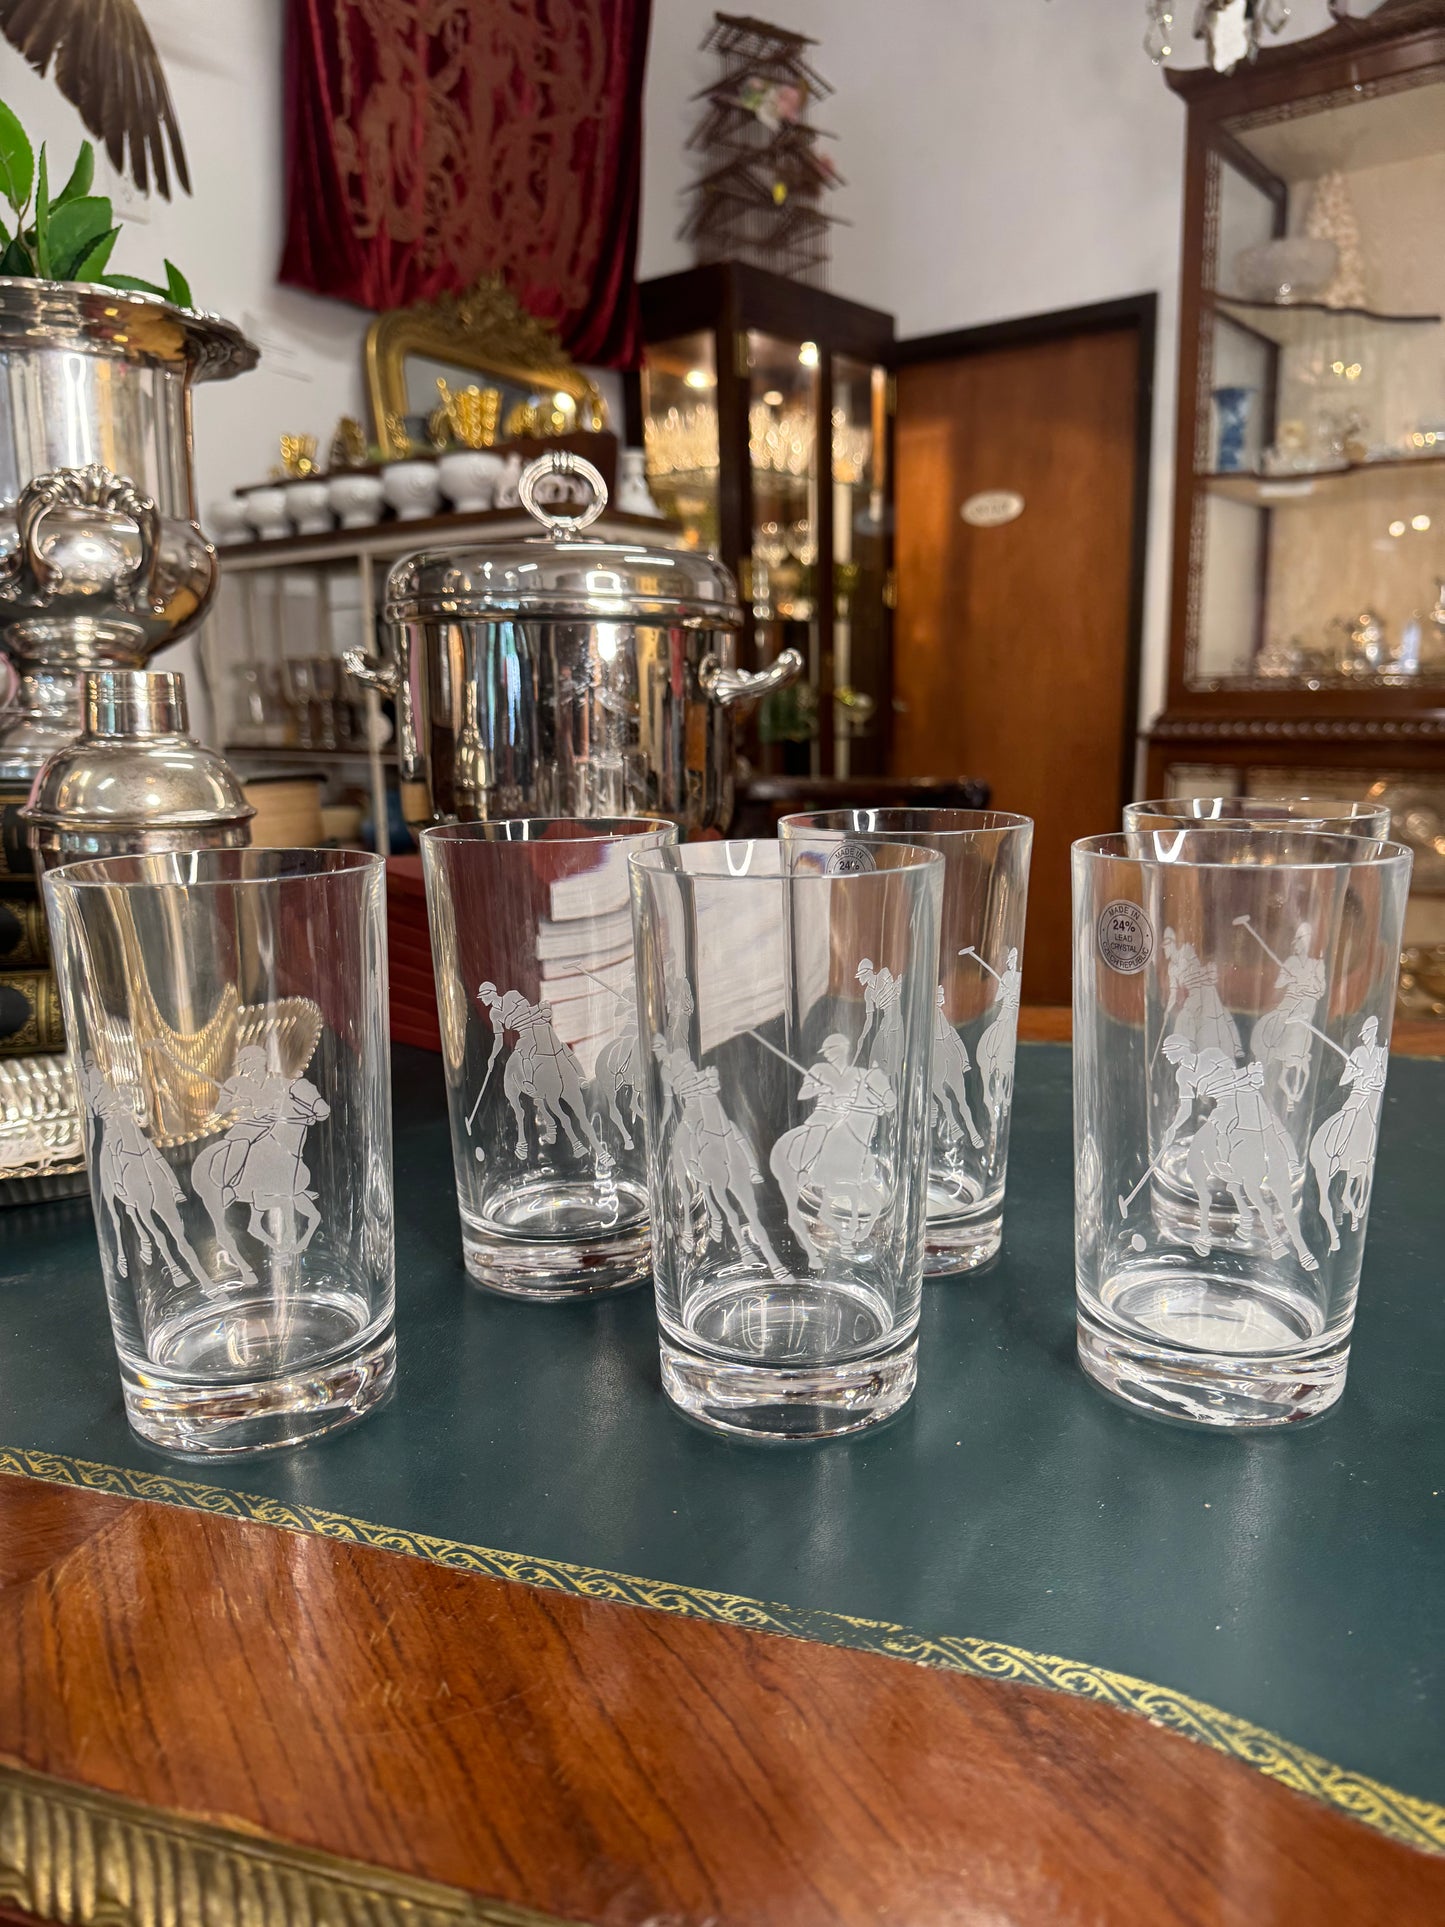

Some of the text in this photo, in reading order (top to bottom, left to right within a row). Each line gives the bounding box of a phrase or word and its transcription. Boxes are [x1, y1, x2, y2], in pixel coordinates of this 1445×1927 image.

[836, 848, 864, 859] MADE IN
[1109, 906, 1140, 920] MADE IN
[1113, 919, 1136, 933] 24%
[1115, 934, 1132, 943] LEAD
[1110, 942, 1137, 953] CRYSTAL
[1102, 941, 1149, 969] CZECH REPUBLIC
